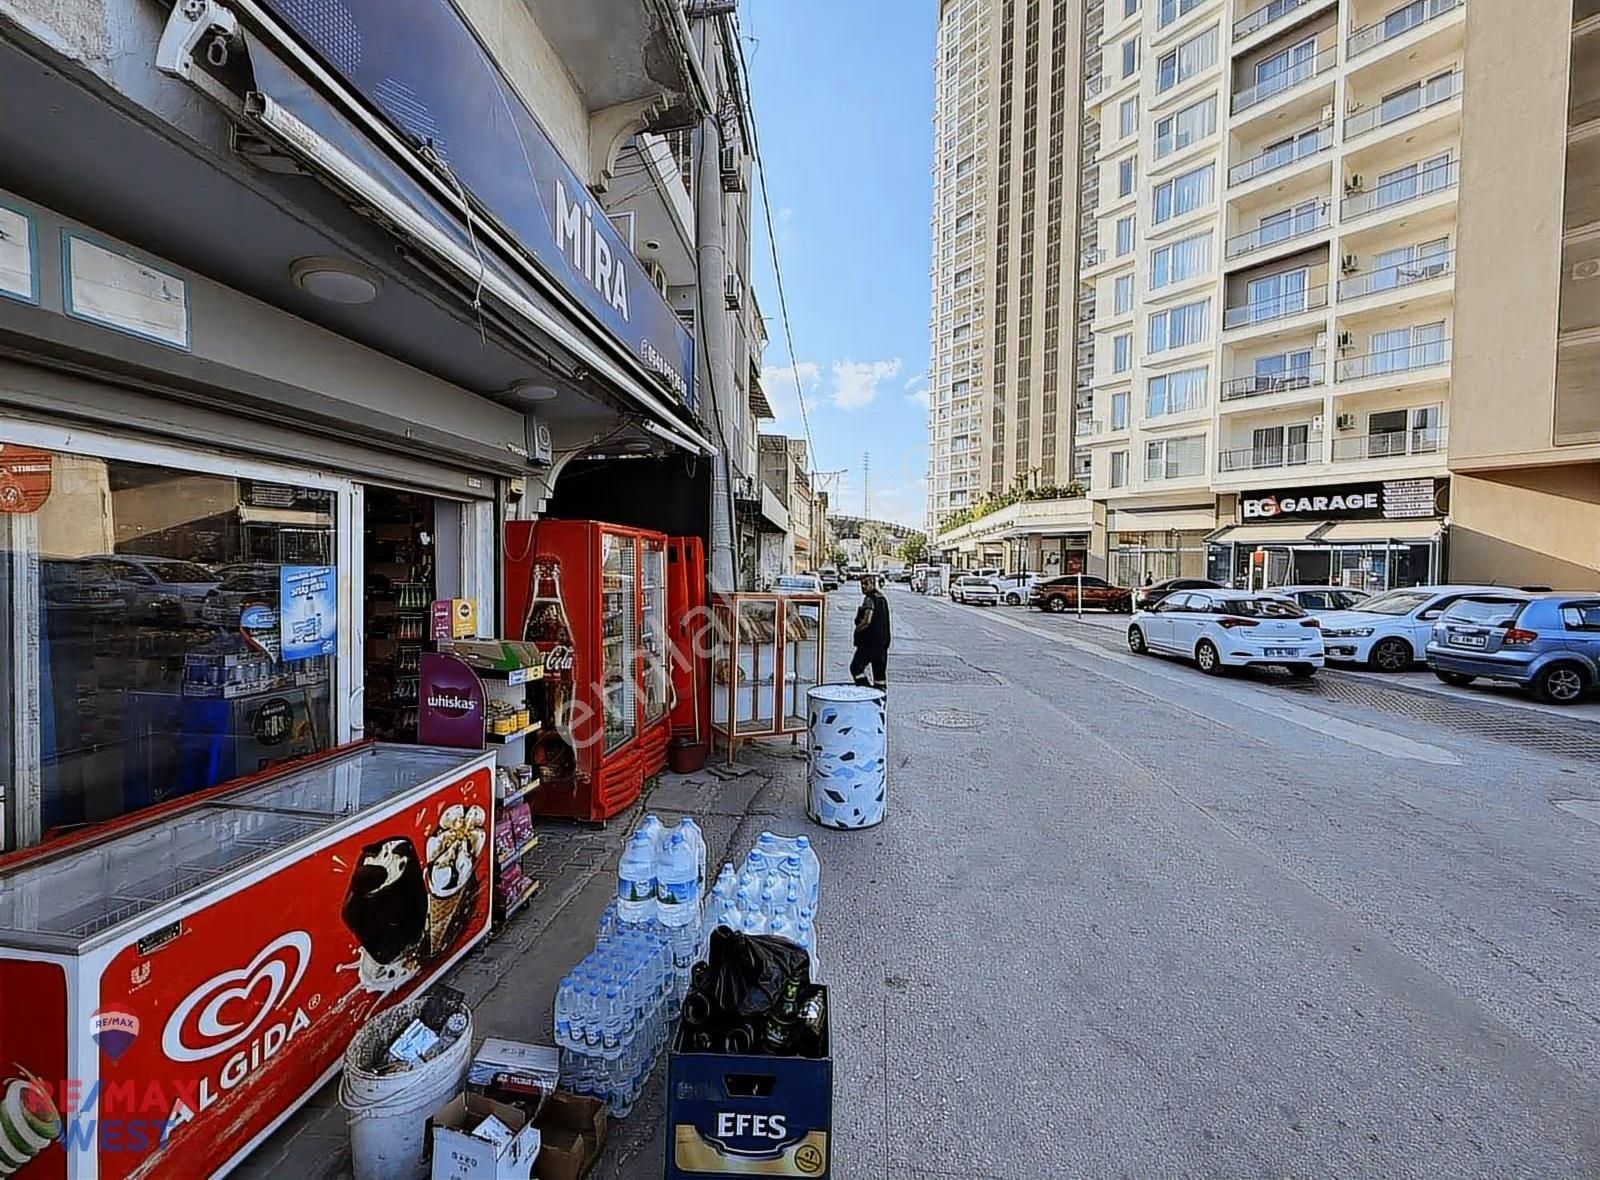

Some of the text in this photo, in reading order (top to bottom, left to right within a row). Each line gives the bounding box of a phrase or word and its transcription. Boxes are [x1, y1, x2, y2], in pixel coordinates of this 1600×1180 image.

[1280, 493, 1378, 512] GARAGE
[428, 694, 475, 710] whiskas
[718, 1112, 787, 1139] EFES
